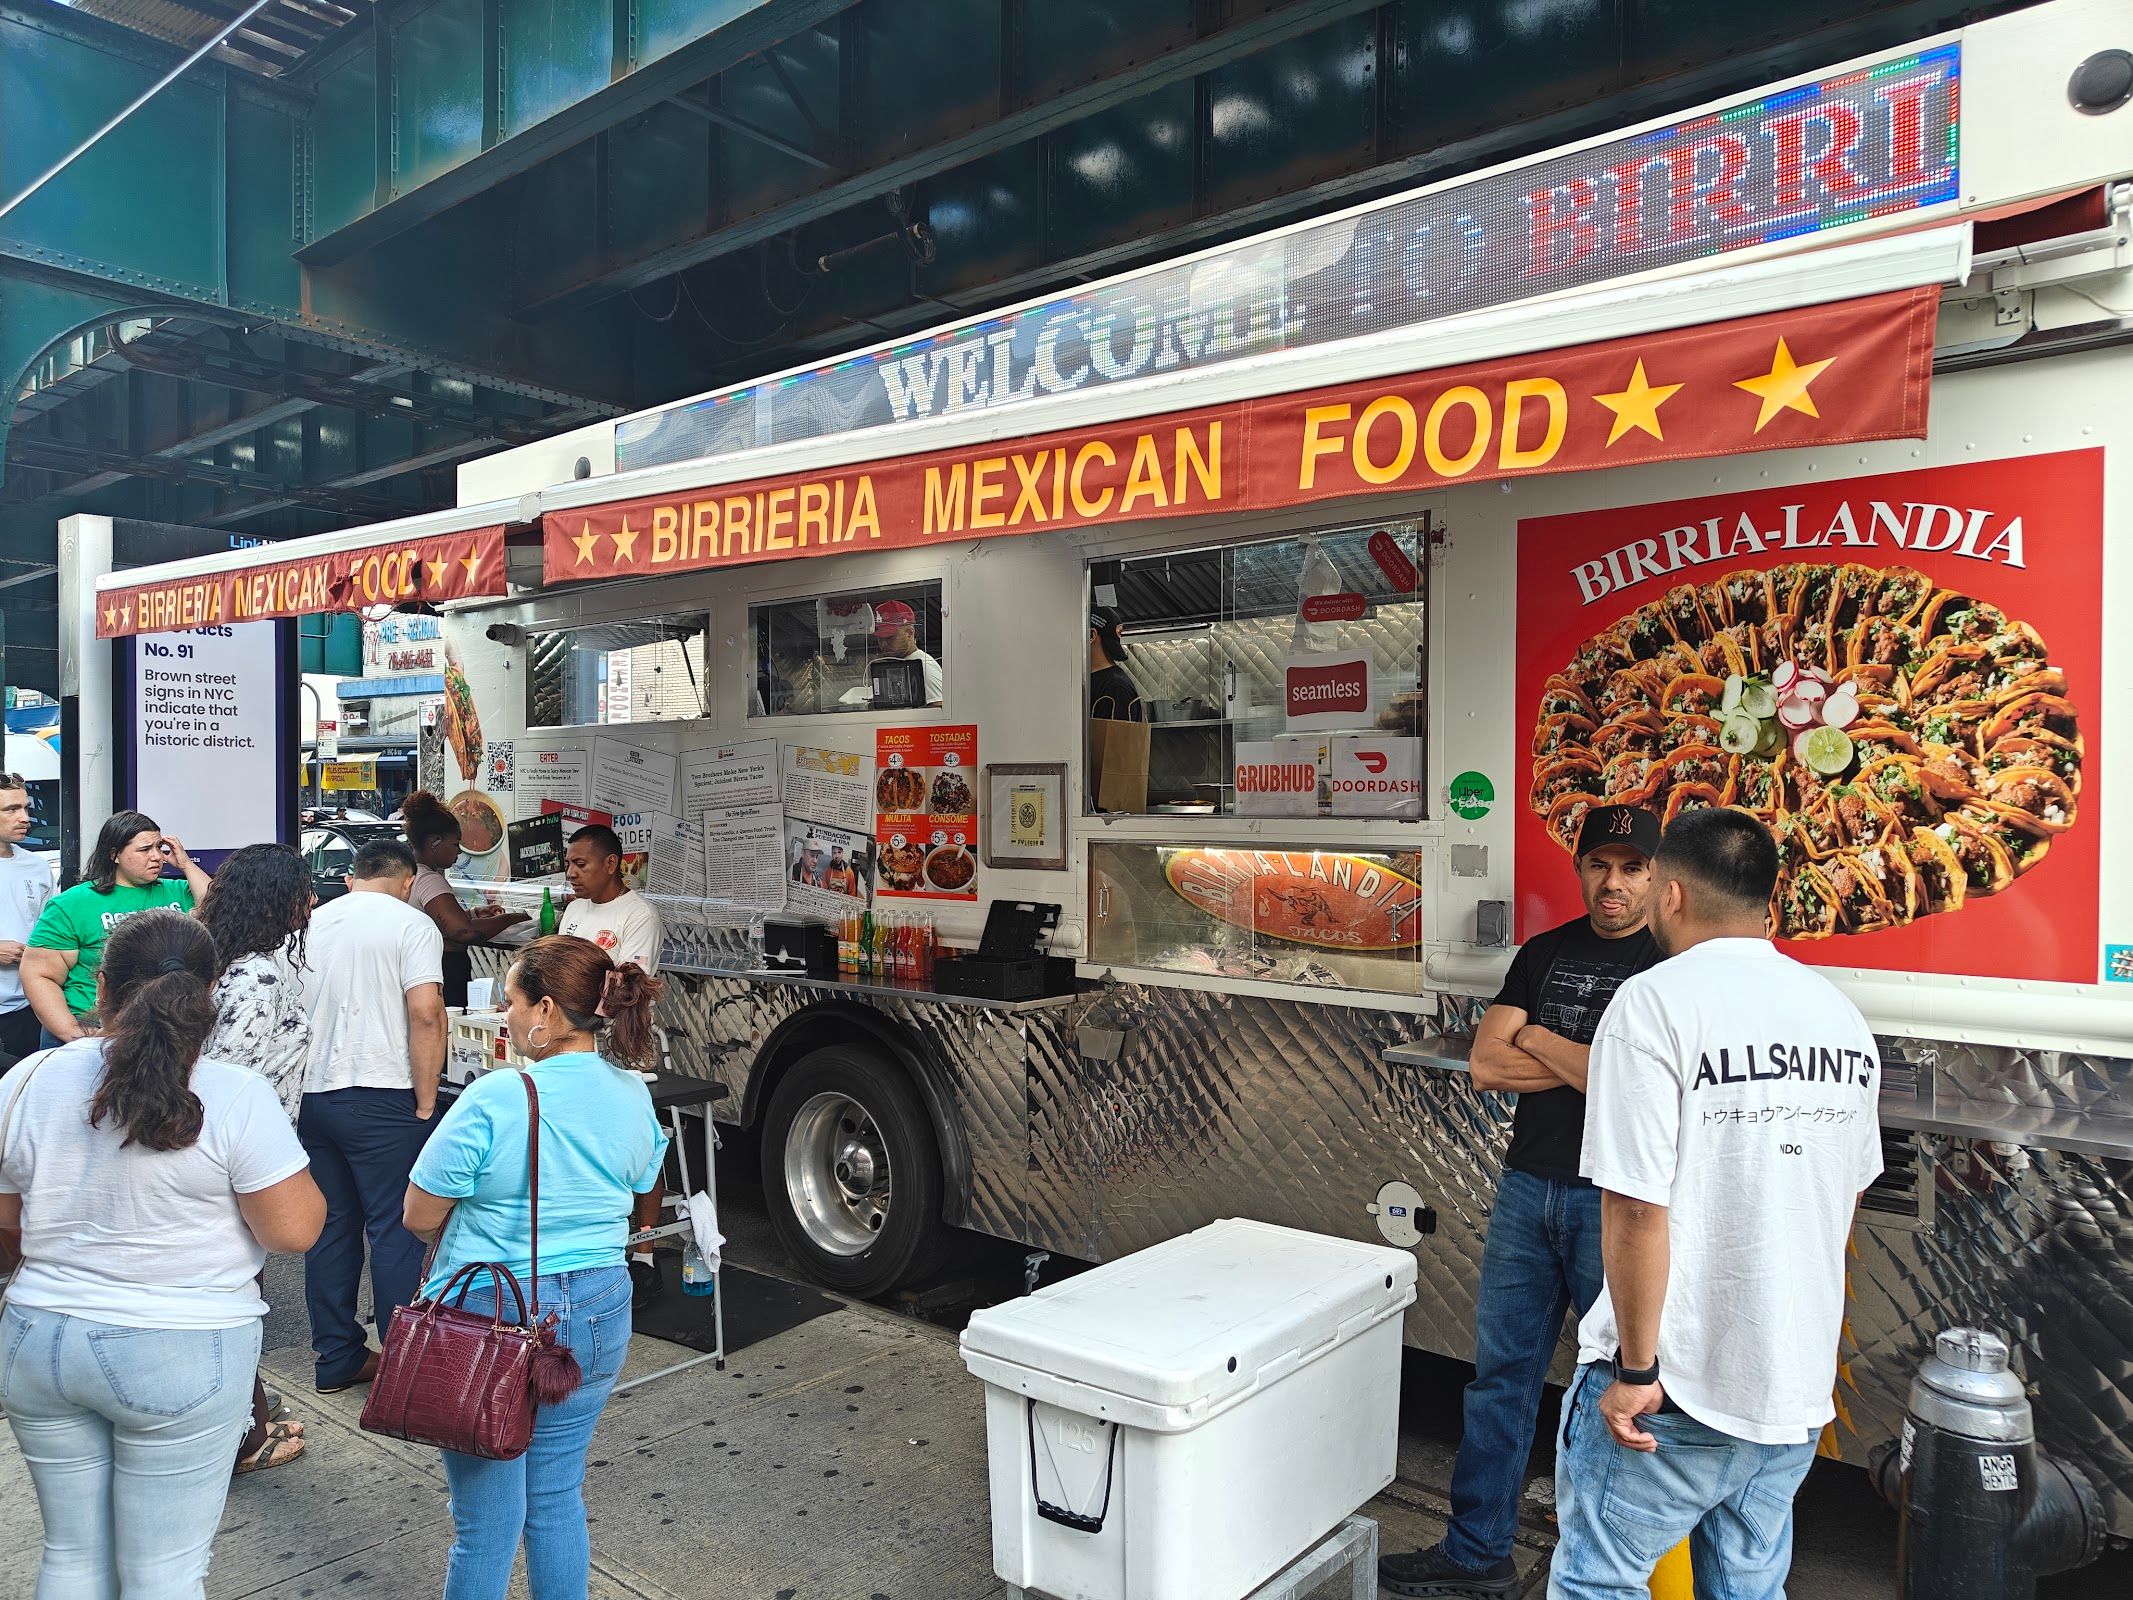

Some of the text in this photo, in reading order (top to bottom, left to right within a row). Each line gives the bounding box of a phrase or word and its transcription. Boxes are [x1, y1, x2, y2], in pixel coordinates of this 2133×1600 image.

[651, 377, 1570, 563] BIRRIERIA MEXICAN FOOD
[1571, 500, 2026, 606] BIRRIA-LANDIA
[1381, 551, 1411, 588] DOORDASH
[138, 583, 222, 629] BIRRIERIA
[235, 563, 328, 617] MEXICAN
[1320, 605, 1361, 614] DOORDASH
[187, 624, 233, 637] acts
[407, 617, 441, 641] SCHOOL
[144, 643, 194, 659] No. 91
[144, 669, 236, 685] Brown street
[144, 685, 234, 702] signs in NYC
[1292, 680, 1360, 702] seamless
[144, 701, 238, 717] indicate that
[144, 718, 219, 733] you're in a
[144, 733, 255, 748] historic district.
[884, 734, 910, 745] TACOS
[929, 732, 971, 743] TOSTADAS
[540, 753, 559, 762] EATER
[702, 771, 723, 780] Brothers
[1236, 764, 1315, 792] GRUBHUB
[1333, 780, 1421, 793] DOORDASH
[1459, 787, 1484, 796] Uber
[546, 815, 560, 824] hulu
[613, 813, 641, 828] FOOD
[885, 814, 912, 823] MULITA
[929, 814, 969, 824] CONSOME
[1609, 809, 1633, 834] NY
[618, 828, 651, 845] SIDER
[815, 829, 851, 840] FUNDACIÓN
[815, 835, 850, 846] PUEBLA USA
[1181, 852, 1423, 926] BIRRIA-LANDIA
[1287, 925, 1364, 944] TACOS
[1693, 1043, 1875, 1091] ALLSAINTS
[1055, 1419, 1095, 1454] 125
